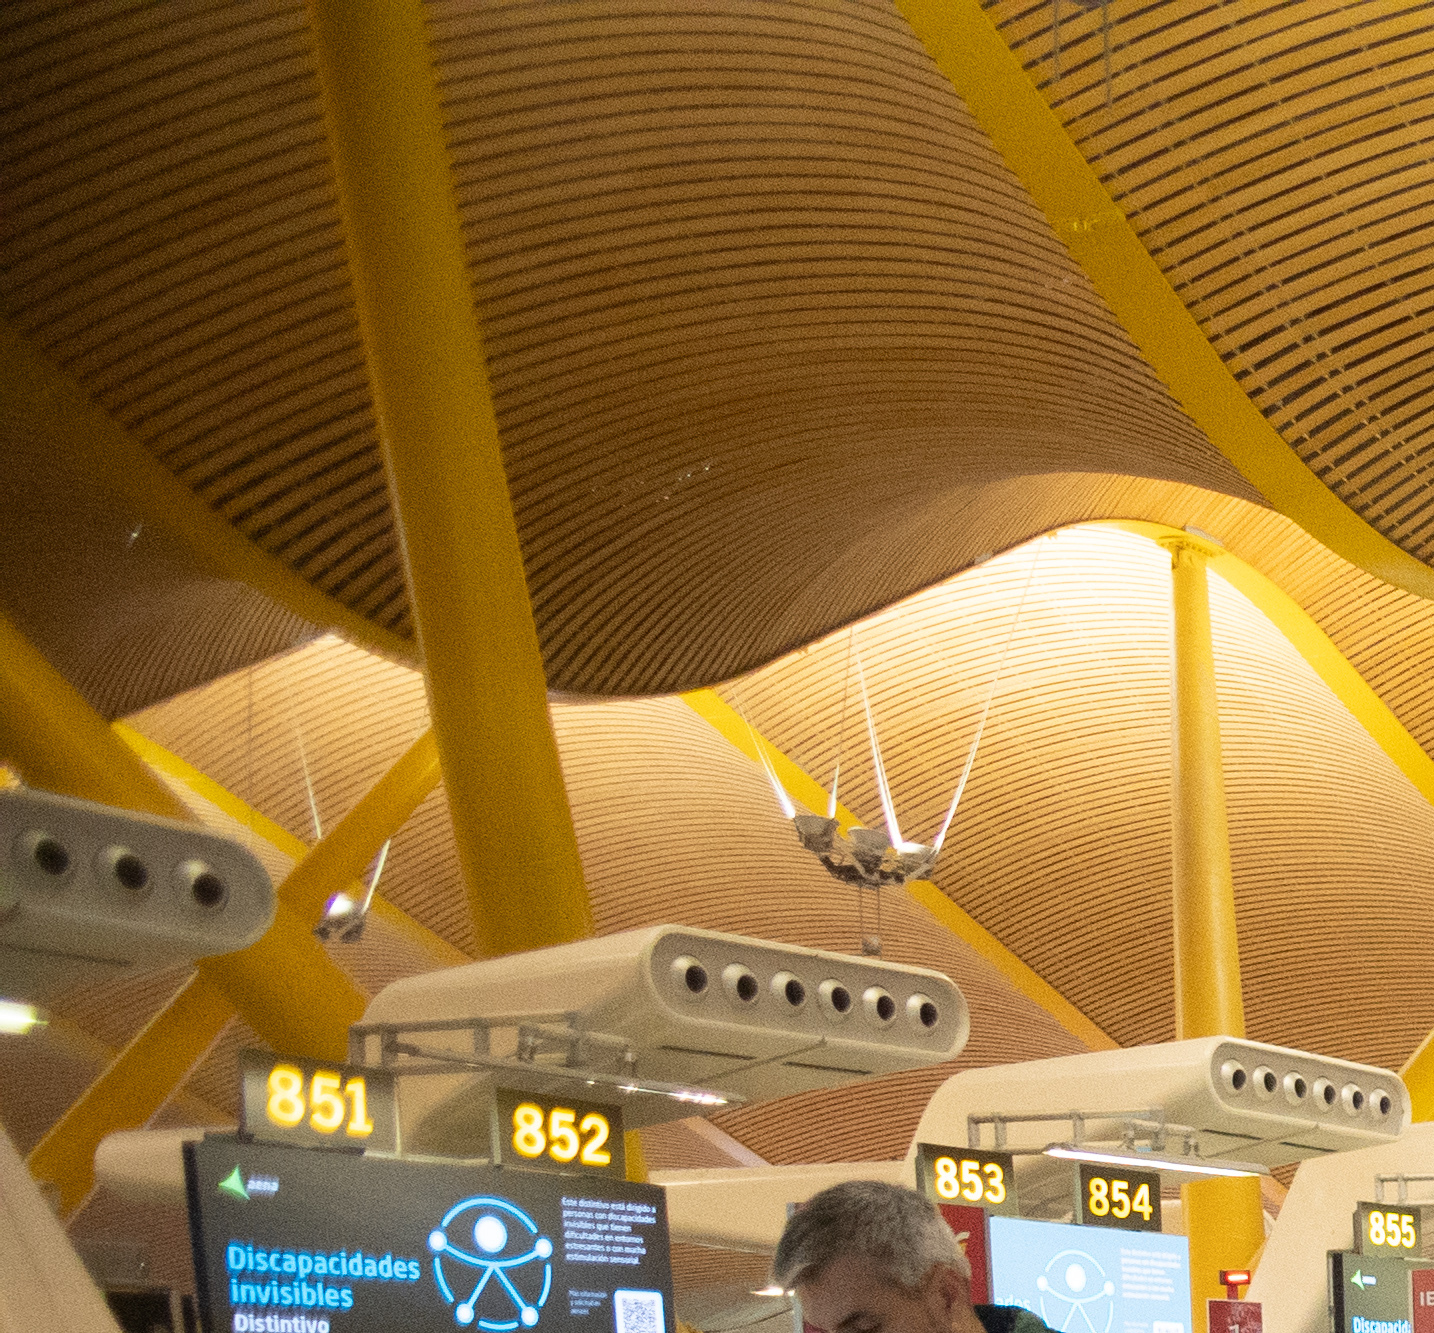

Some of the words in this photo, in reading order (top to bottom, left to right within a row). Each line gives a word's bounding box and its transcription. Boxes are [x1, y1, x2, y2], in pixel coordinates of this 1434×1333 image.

[266, 1063, 374, 1138] 851
[511, 1102, 612, 1167] 852
[934, 1155, 1007, 1205] 853
[1088, 1176, 1153, 1223] 854
[1368, 1210, 1417, 1248] 855
[227, 1242, 420, 1281] Discapacidades
[230, 1281, 354, 1309] invisibles
